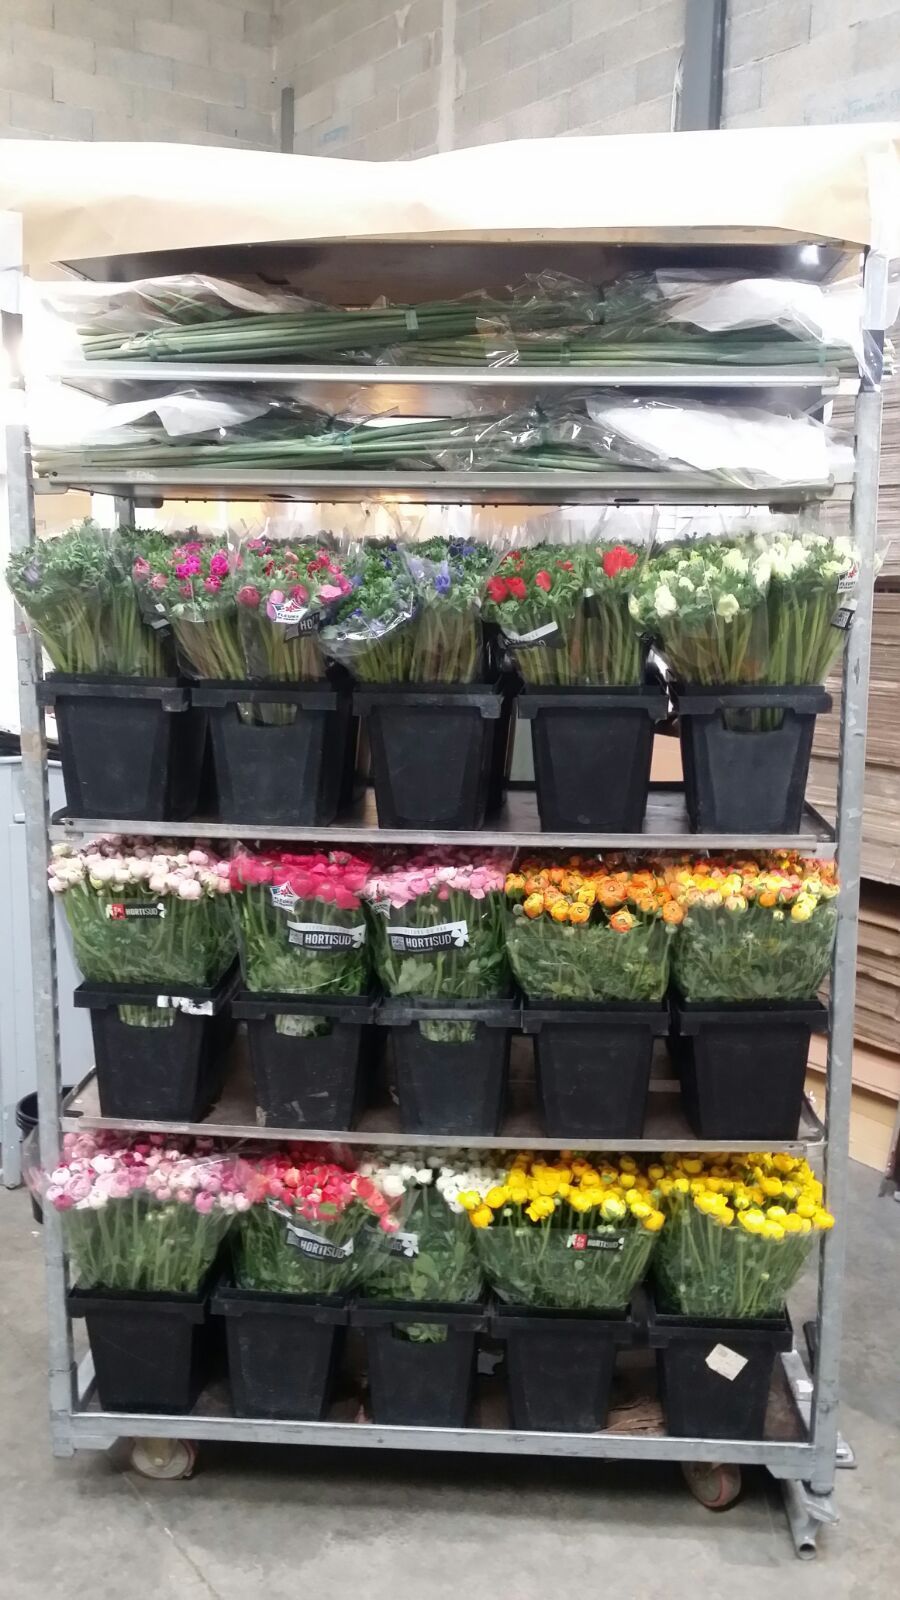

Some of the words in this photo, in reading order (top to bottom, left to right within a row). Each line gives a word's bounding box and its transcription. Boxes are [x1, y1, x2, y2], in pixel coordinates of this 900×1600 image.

[125, 908, 158, 916] HORTISUD
[305, 933, 352, 945] HORTISUD
[405, 934, 452, 948] HORTISUD
[300, 1239, 345, 1259] HORTISUD
